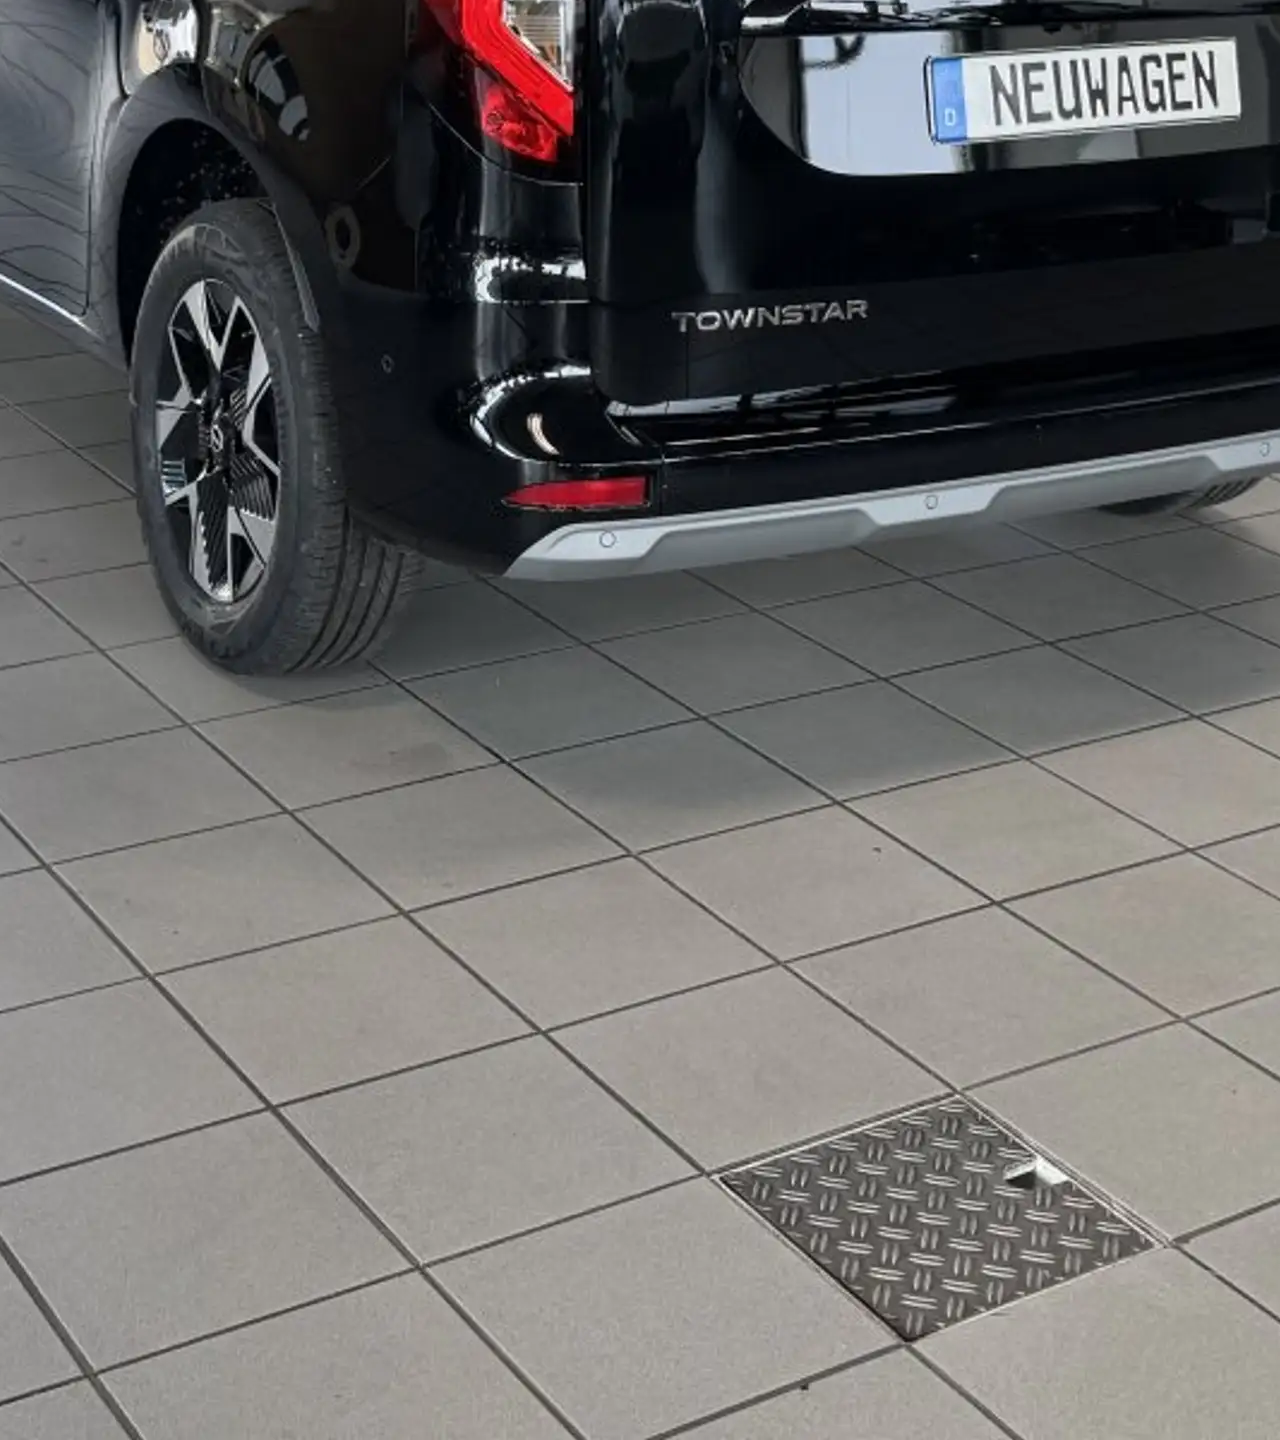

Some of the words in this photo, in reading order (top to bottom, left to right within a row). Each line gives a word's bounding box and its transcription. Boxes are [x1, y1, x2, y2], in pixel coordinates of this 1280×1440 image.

[944, 108, 956, 126] D
[989, 50, 1219, 126] NEUWAGEN
[671, 300, 868, 333] TOWNSTAR
